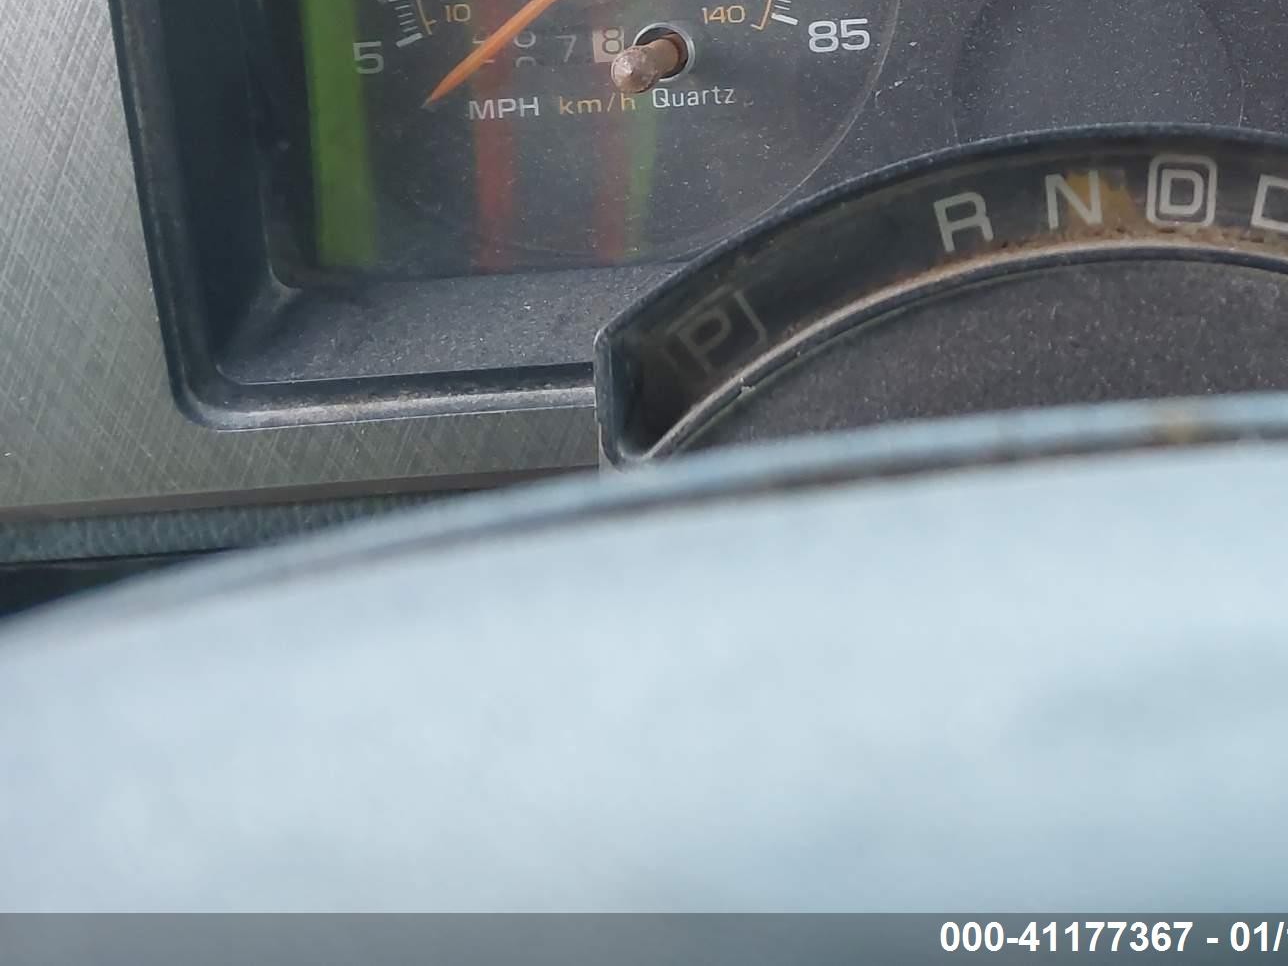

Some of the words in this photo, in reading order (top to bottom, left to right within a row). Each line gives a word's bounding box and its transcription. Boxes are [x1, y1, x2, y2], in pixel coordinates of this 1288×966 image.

[444, 4, 471, 22] 10
[701, 4, 746, 25] 140
[807, 19, 871, 52] 85
[353, 42, 385, 74] 5
[468, 96, 540, 121] MPH
[558, 92, 637, 115] km/h
[651, 85, 736, 109] Quartz
[1045, 170, 1102, 230] N
[1159, 168, 1206, 215] D
[933, 191, 994, 252] R
